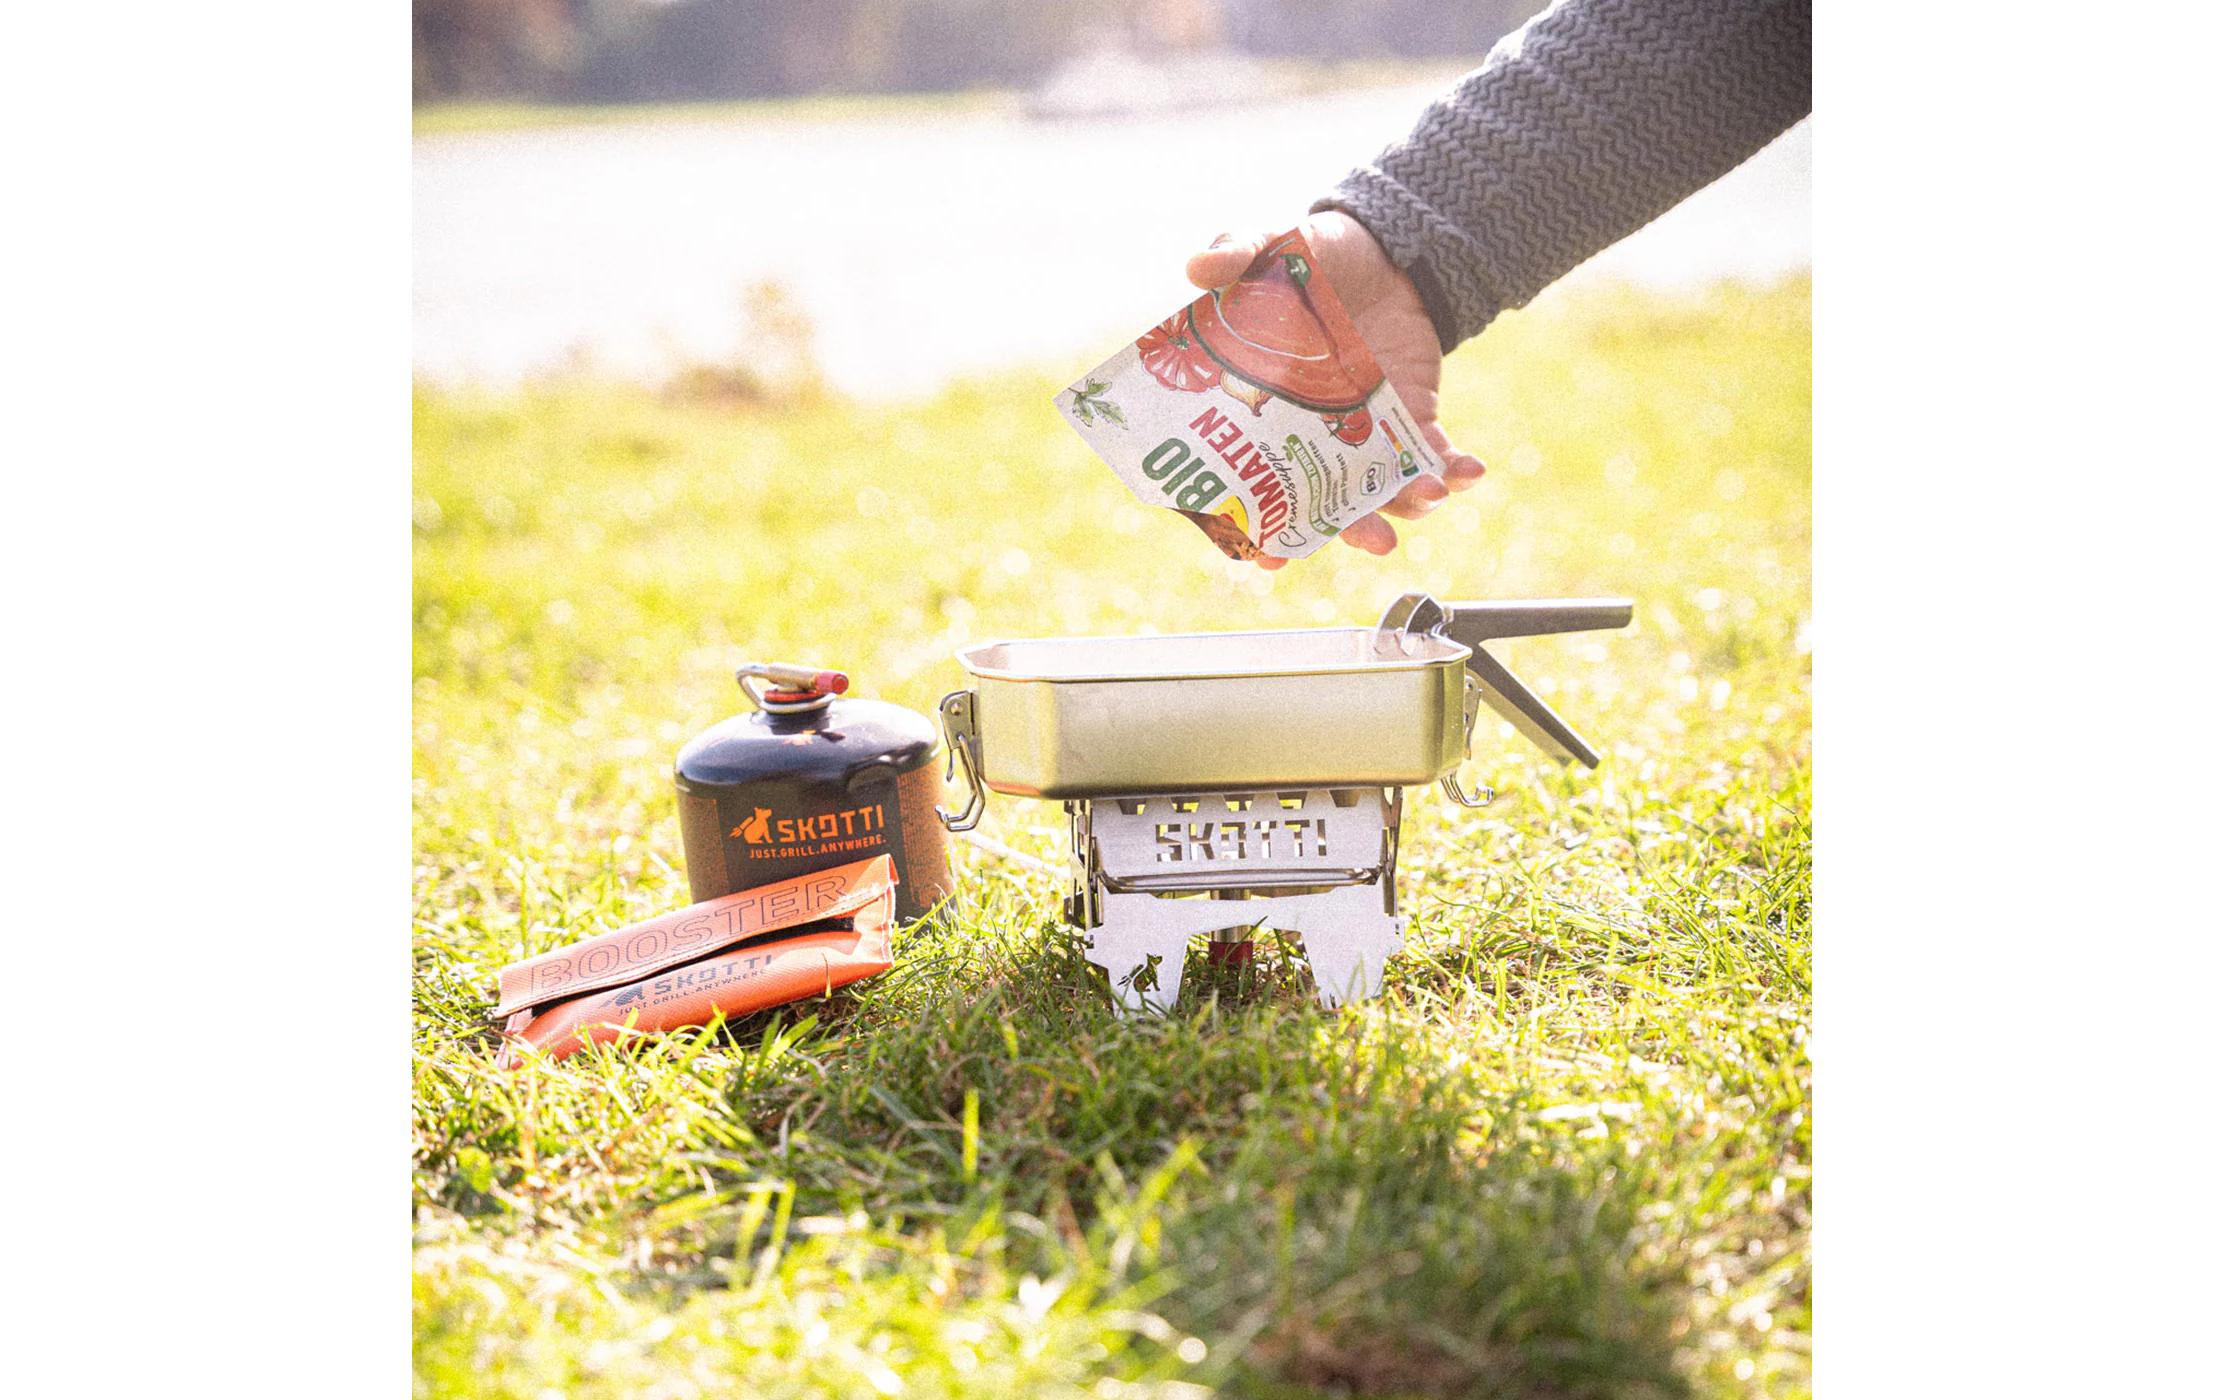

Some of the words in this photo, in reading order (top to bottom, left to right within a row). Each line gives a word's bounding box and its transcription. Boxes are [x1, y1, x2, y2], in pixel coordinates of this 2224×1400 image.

[1142, 437, 1228, 512] BIO
[1188, 406, 1288, 548] TOMATEN
[1258, 441, 1307, 547] Cremesuppe
[777, 804, 884, 843] SKOTTI
[1155, 819, 1327, 862] SKOTTI
[530, 875, 847, 993] BOOSTER
[655, 954, 772, 995] SKOTTI
